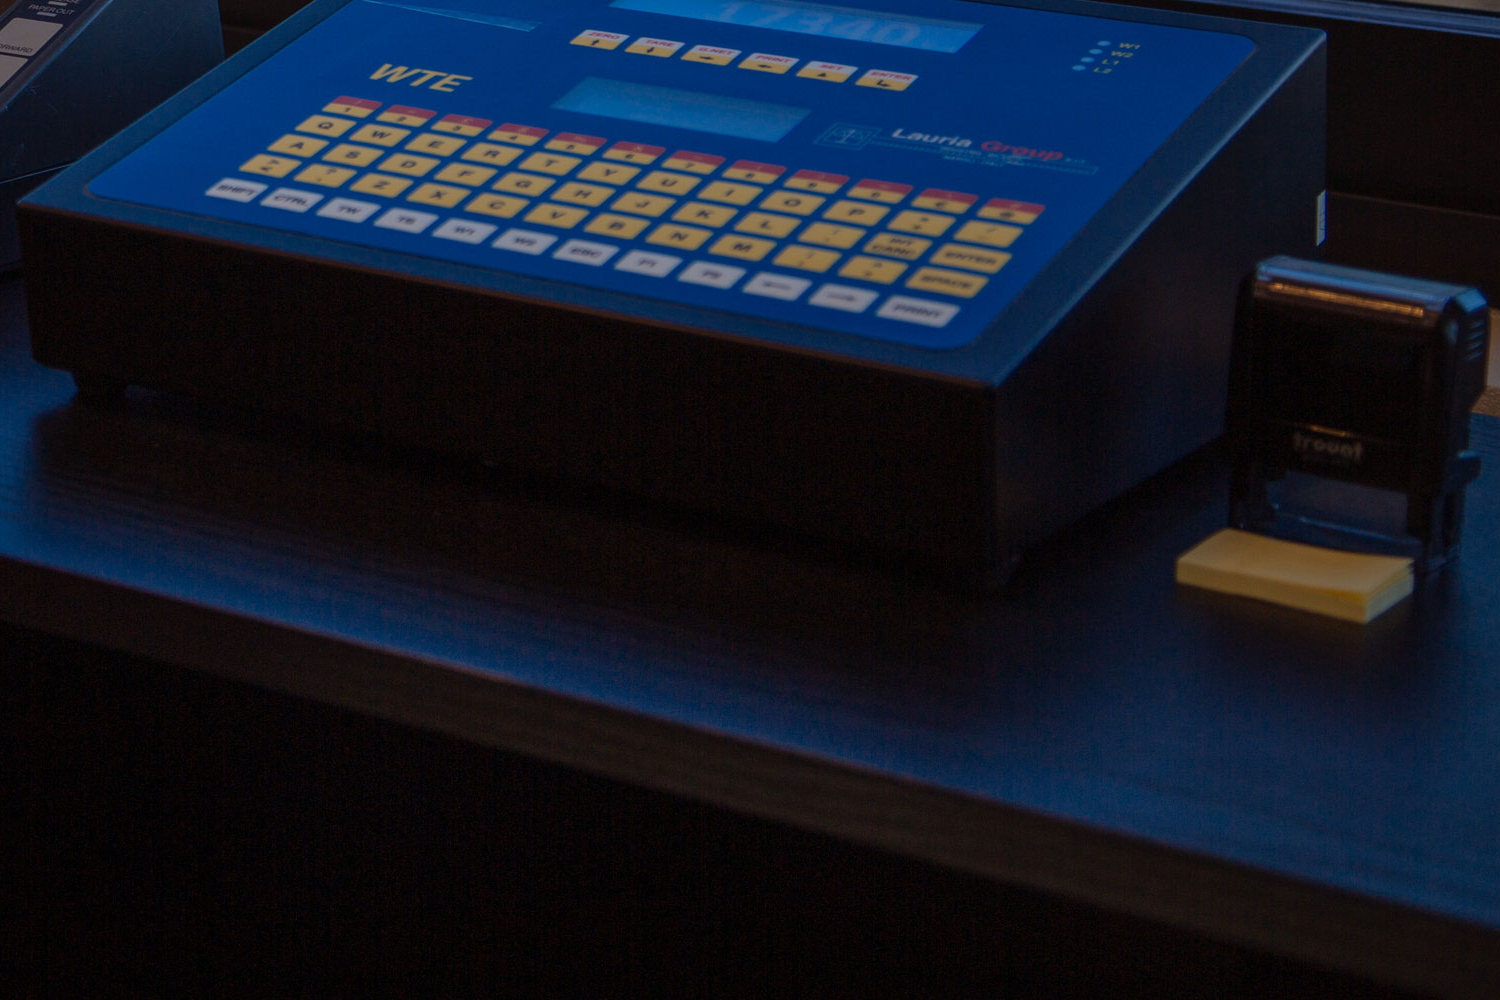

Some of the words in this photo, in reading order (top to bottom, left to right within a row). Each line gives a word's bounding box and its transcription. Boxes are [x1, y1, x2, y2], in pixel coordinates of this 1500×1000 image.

[28, 4, 57, 14] PAPER
[54, 8, 76, 16] OUT
[588, 31, 621, 40] ZERO
[645, 39, 677, 47] TARE
[368, 63, 474, 93] WTE
[290, 141, 306, 150] A
[317, 121, 334, 130] Q
[371, 130, 392, 139] W
[545, 159, 560, 168] T
[891, 127, 973, 149] Lauria
[980, 140, 1064, 162] Group
